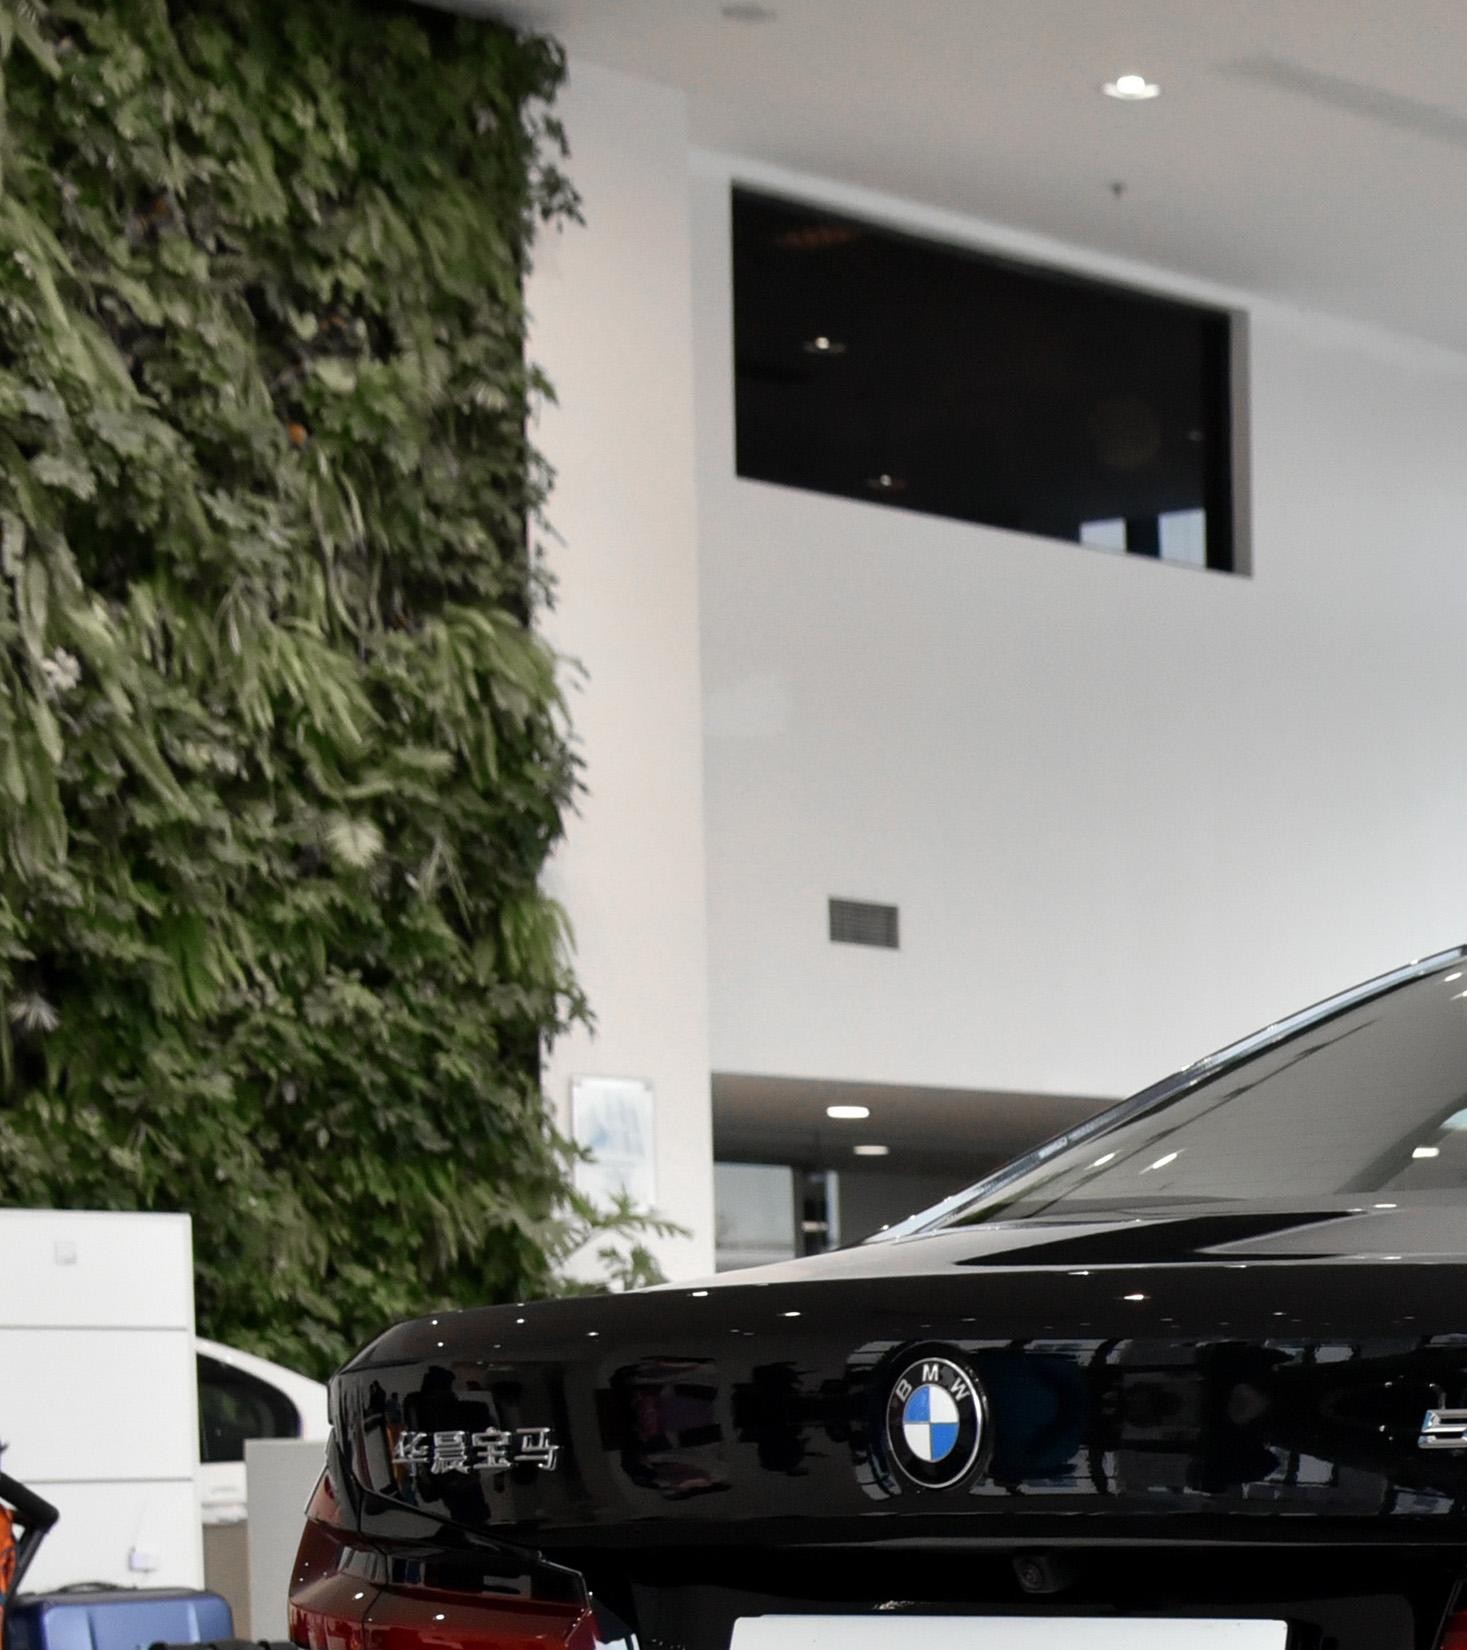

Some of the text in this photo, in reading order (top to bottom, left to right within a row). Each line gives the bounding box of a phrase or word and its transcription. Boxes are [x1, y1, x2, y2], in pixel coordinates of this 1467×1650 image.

[895, 1363, 970, 1402] BMW
[391, 1426, 560, 1477] 华晨宝马
